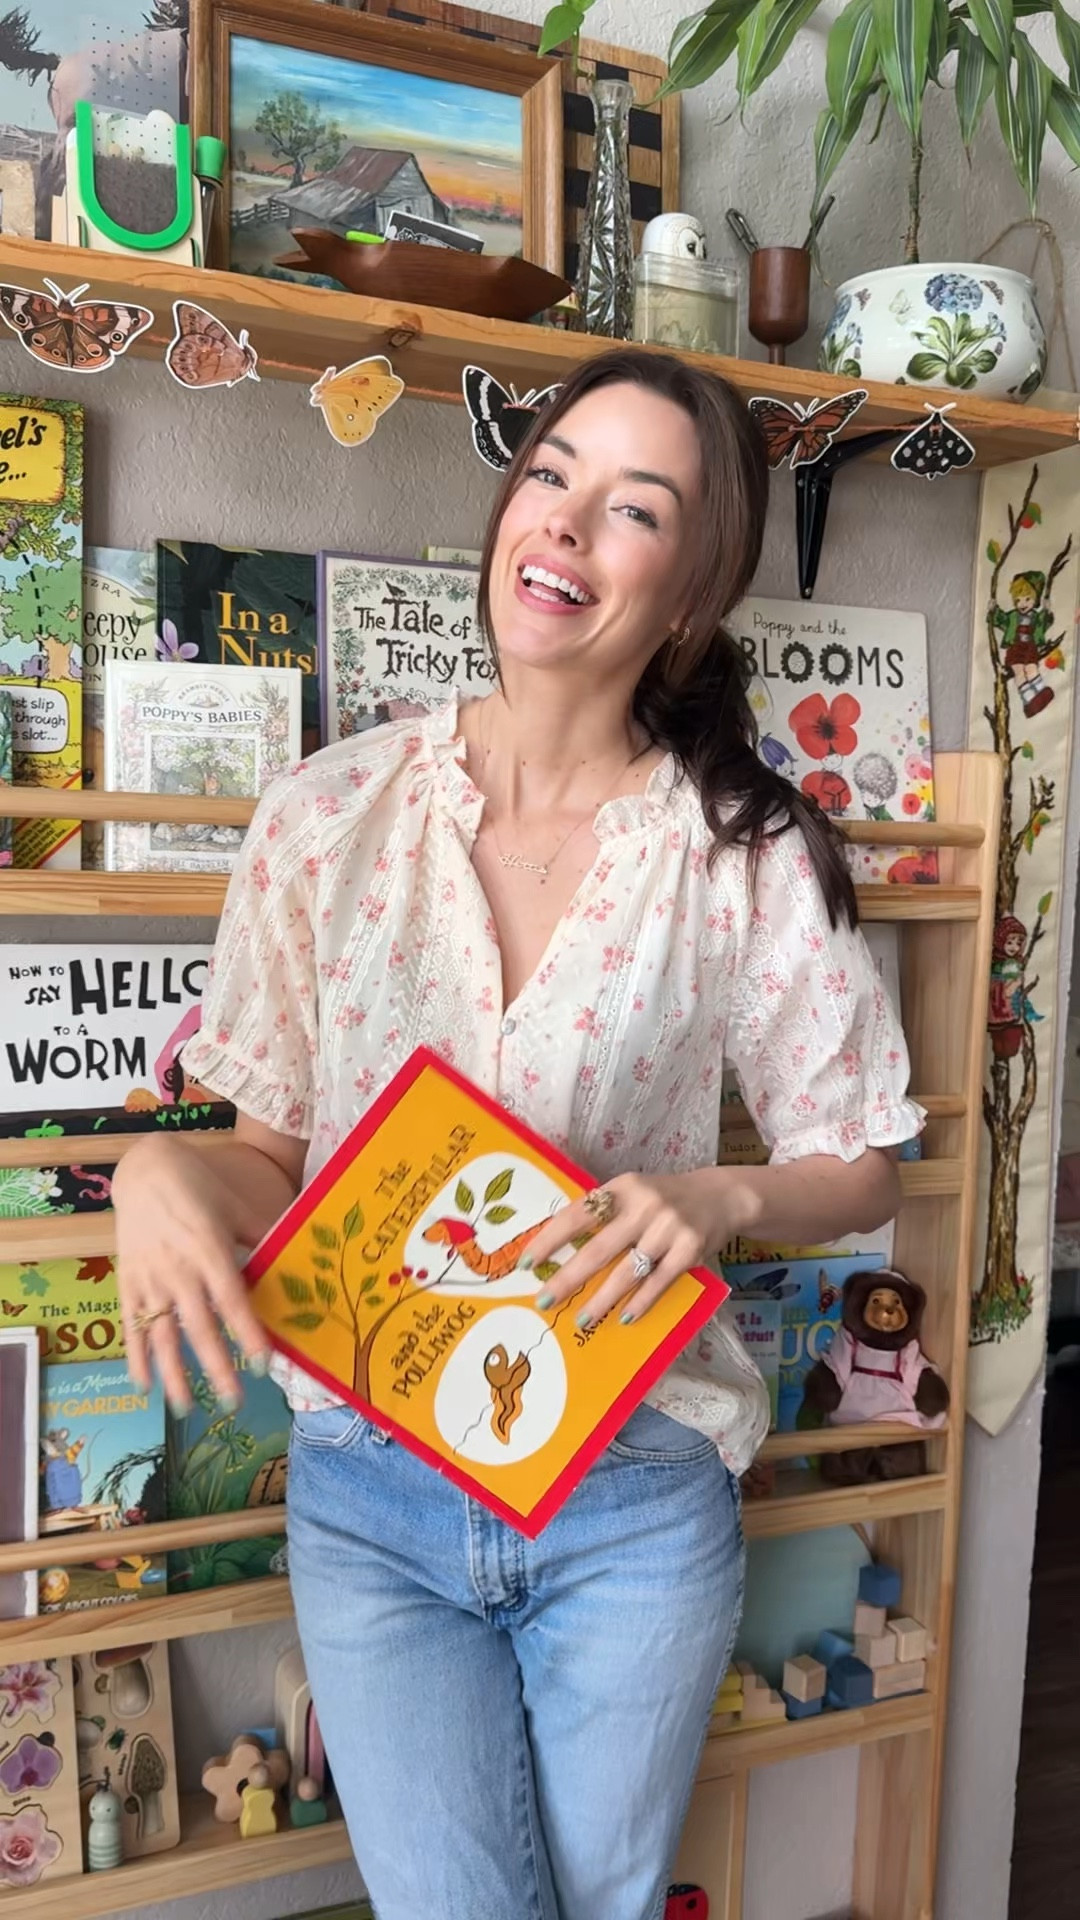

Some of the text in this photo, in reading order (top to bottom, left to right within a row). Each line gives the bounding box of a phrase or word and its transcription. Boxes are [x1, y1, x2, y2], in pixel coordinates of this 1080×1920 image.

[0, 416, 47, 450] el's
[84, 611, 142, 646] eepy
[218, 592, 290, 635] In a
[353, 597, 472, 641] The Tale of
[753, 611, 848, 640] Poppy and the
[376, 637, 459, 684] Tricky
[739, 635, 905, 690] BLOOMS
[15, 711, 67, 729] through
[30, 697, 56, 713] slip
[142, 706, 263, 724] POPPY'S BABIES
[9, 965, 65, 981] HOW TO
[24, 957, 209, 1017] SAY HELLO
[53, 1023, 89, 1037] TO A
[5, 1036, 147, 1086] WORM
[373, 1159, 413, 1200] The
[40, 1297, 122, 1318] The Magi
[390, 1304, 446, 1371] and the
[391, 1300, 477, 1400] POLLIWOG
[61, 1393, 150, 1419] GARDEN
